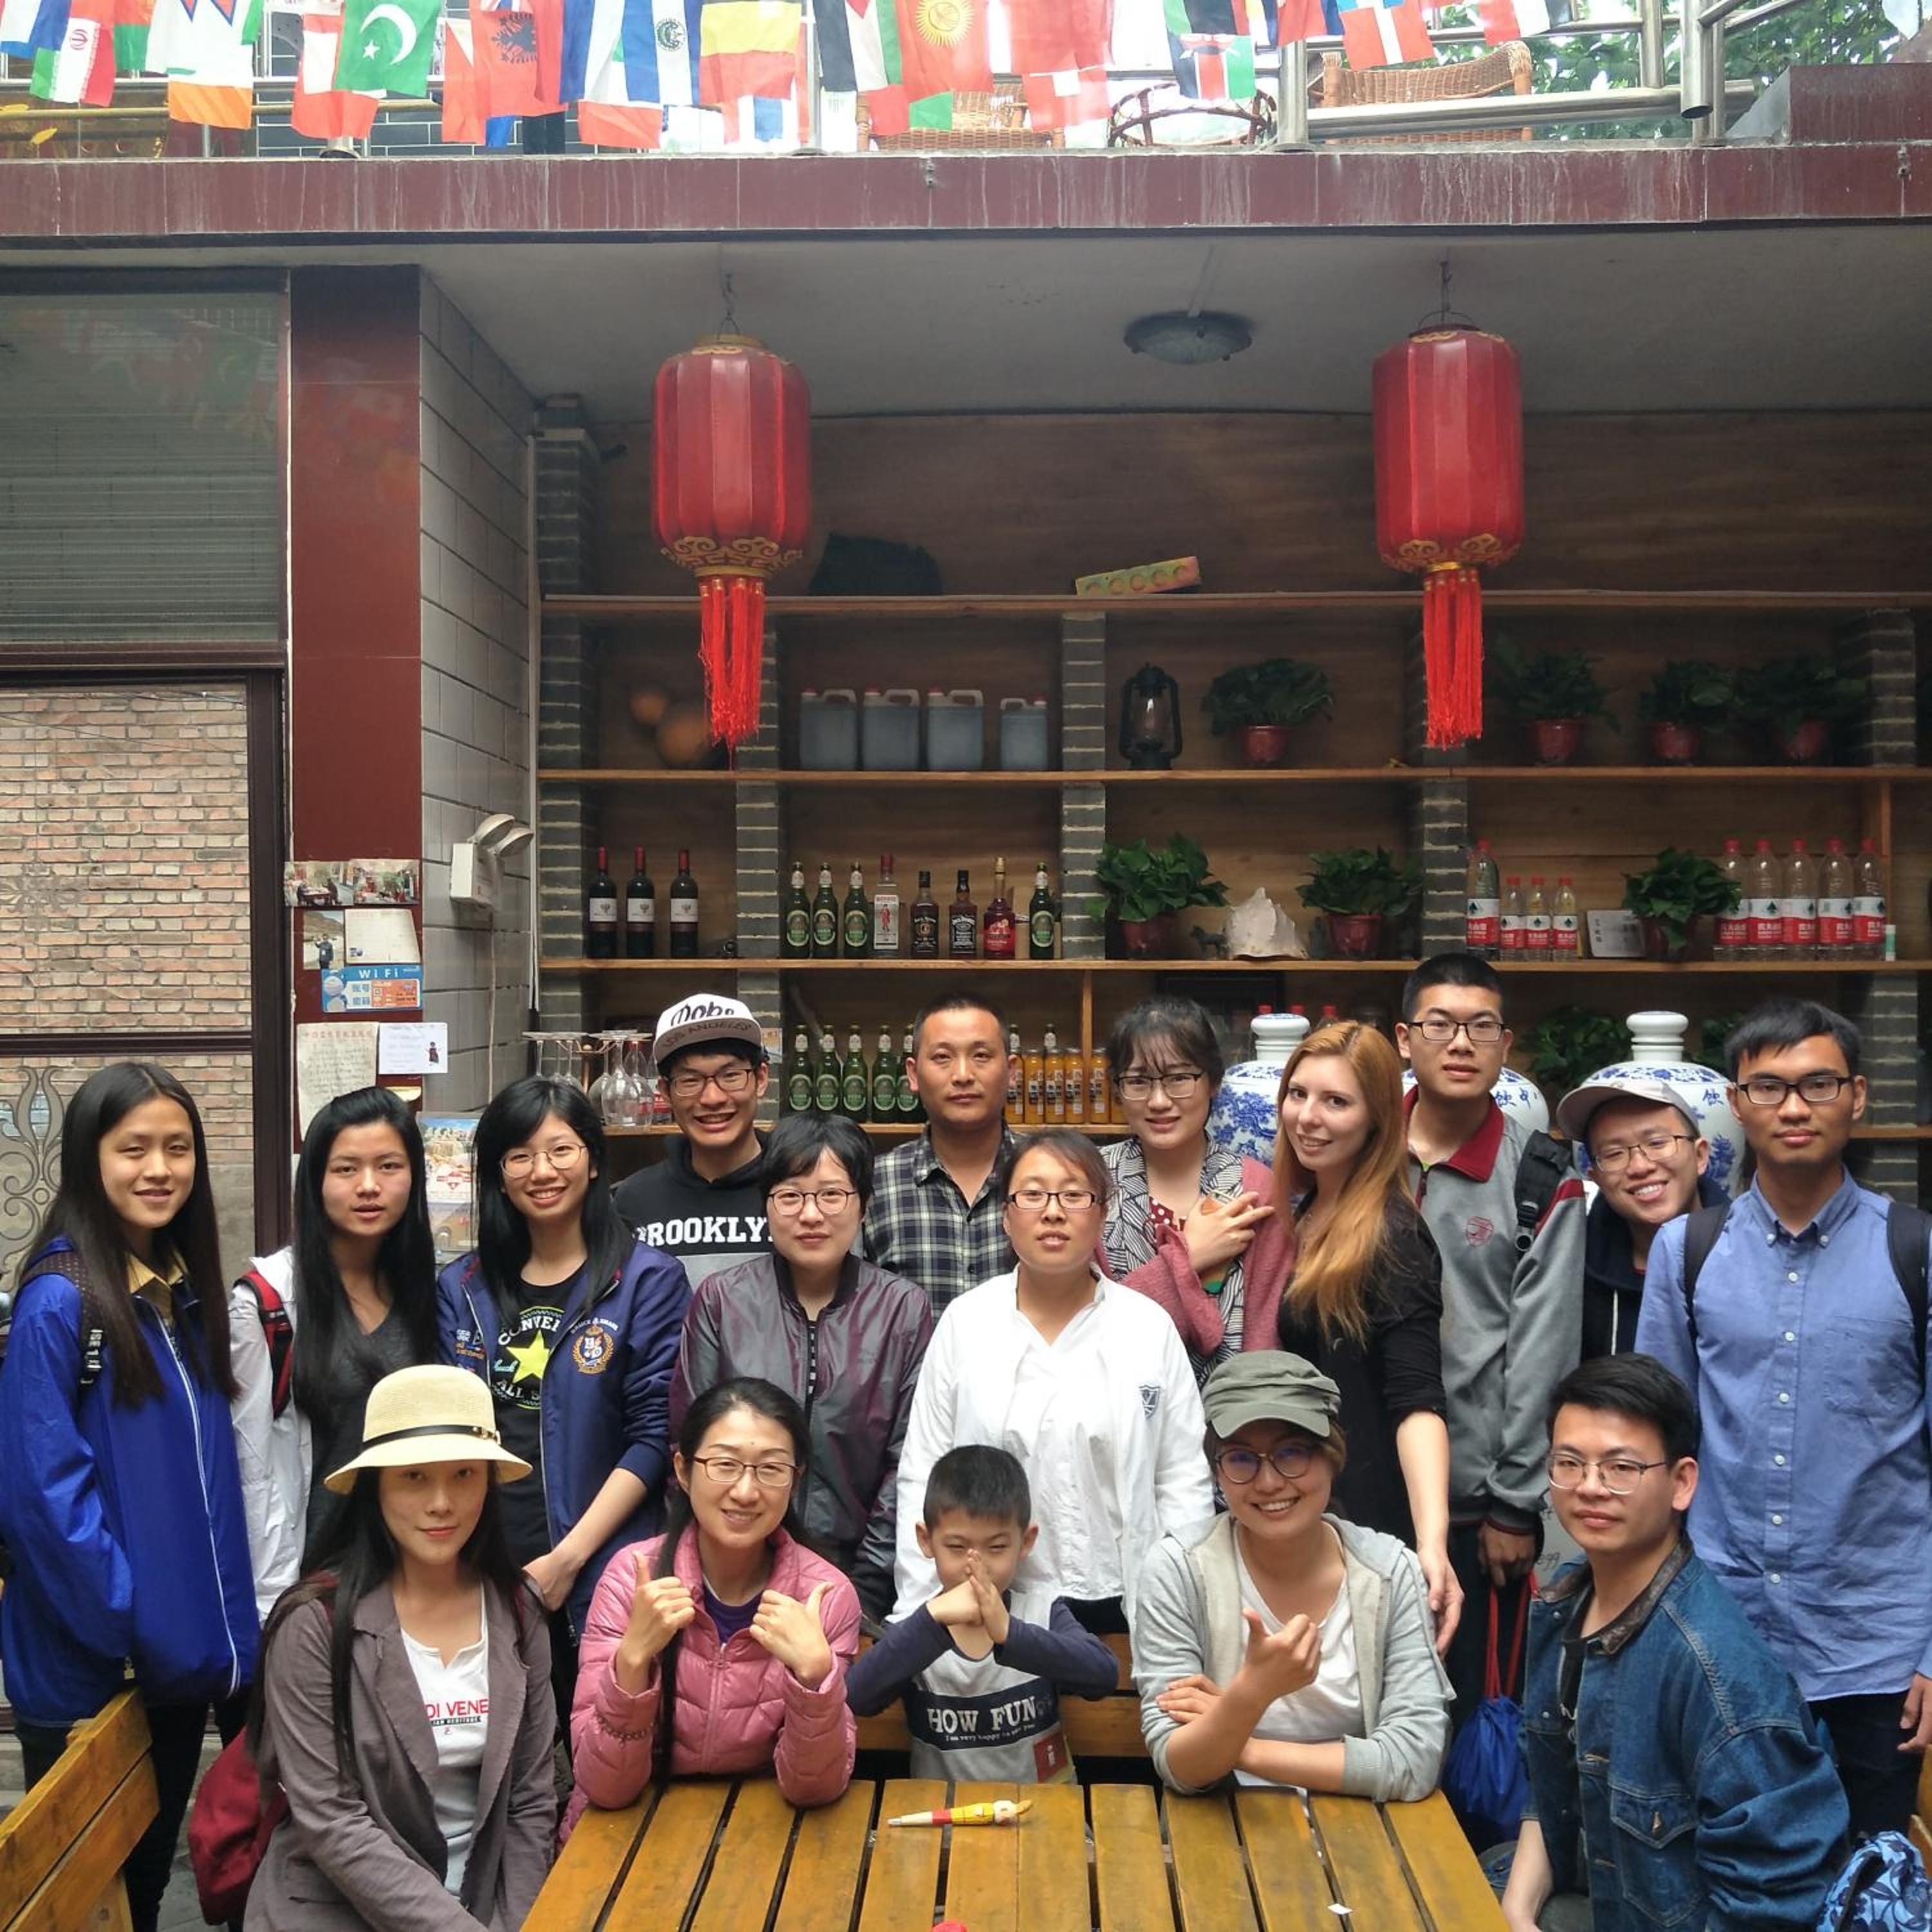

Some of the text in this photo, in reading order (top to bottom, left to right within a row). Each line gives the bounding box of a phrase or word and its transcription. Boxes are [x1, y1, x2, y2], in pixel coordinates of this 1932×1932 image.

[632, 1216, 773, 1247] ROOKLY
[927, 1709, 979, 1734] HOW
[990, 1697, 1036, 1730] FUN
